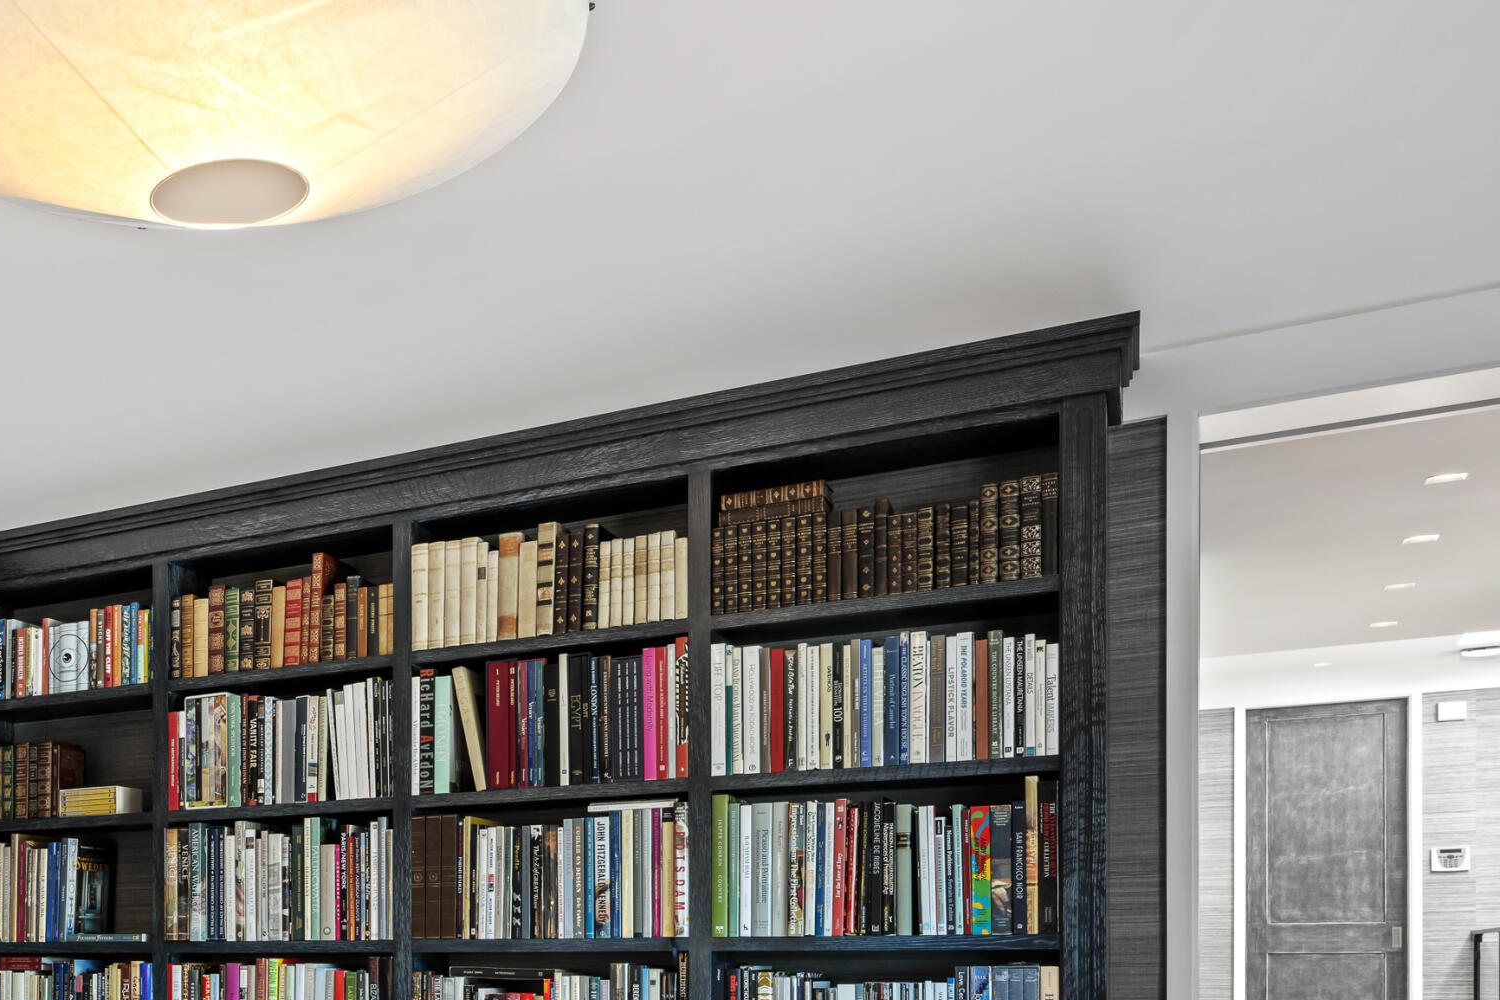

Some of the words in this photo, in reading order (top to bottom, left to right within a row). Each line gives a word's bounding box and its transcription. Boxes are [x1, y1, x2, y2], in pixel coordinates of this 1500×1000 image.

[646, 655, 654, 677] Living
[912, 645, 924, 689] BEATON
[912, 690, 923, 703] IN
[1026, 672, 1034, 694] DETAILS
[1046, 674, 1057, 701] Talent
[570, 694, 581, 730] EGYPT
[646, 695, 654, 733] Modernity
[833, 707, 843, 723] 100
[912, 704, 924, 742] VOGUE
[1047, 702, 1055, 734] MAKERS
[789, 804, 798, 863] Impressionism:
[873, 801, 881, 844] JACQUELINE
[761, 829, 769, 852] Picasso
[873, 844, 881, 854] DE
[1015, 831, 1023, 844] SAN
[168, 844, 176, 880] VENICE
[181, 844, 189, 880] VENICE
[761, 853, 769, 866] and
[789, 864, 798, 875] The
[873, 855, 881, 875] RIBES
[1015, 845, 1023, 881] FRANCISCO
[789, 878, 797, 896] First
[789, 897, 798, 935] Collectors
